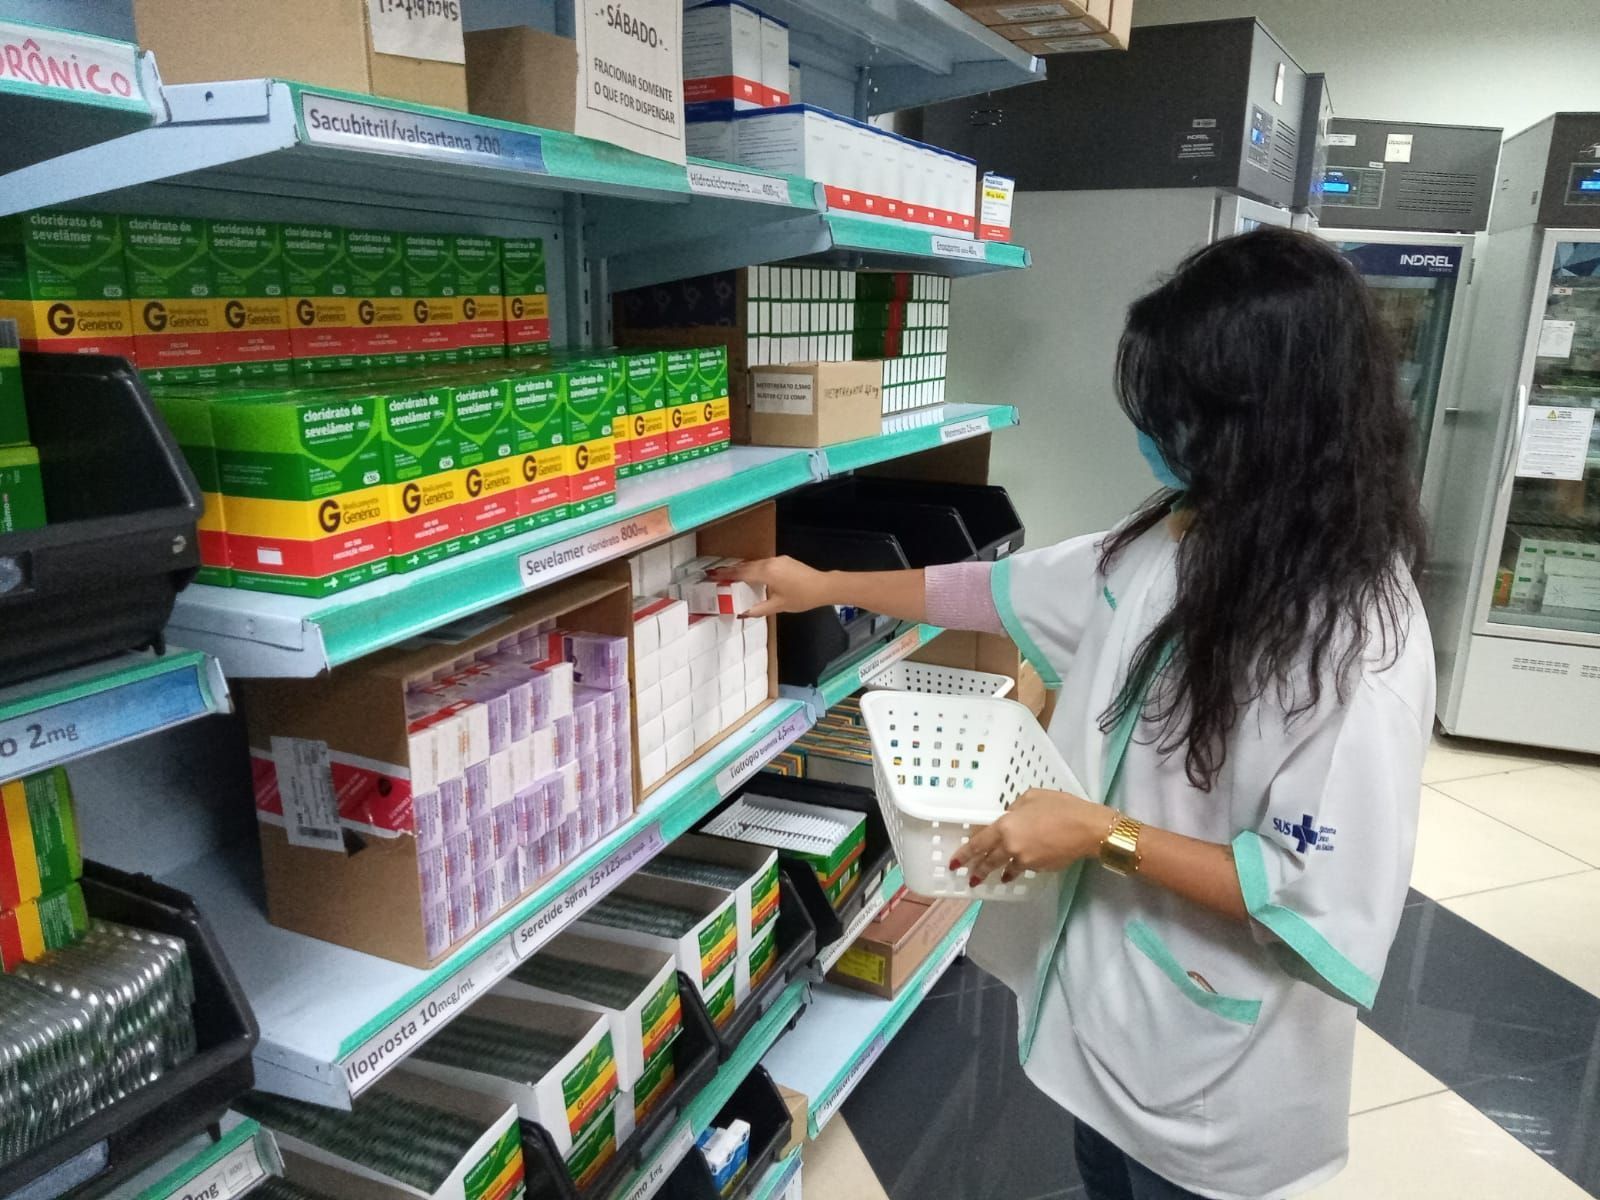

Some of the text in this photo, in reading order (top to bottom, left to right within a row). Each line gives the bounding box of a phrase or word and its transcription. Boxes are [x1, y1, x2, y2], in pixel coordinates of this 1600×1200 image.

[607, 3, 657, 48] SÁBADO
[594, 57, 637, 89] FRACIONAR
[638, 77, 673, 103] SOMENTE
[594, 81, 675, 125] O QUE FOR DISPENSAR
[310, 108, 472, 152] Sacubitril/valsartana
[30, 213, 88, 228] cloridrato
[1400, 254, 1454, 268] INDREL
[47, 302, 75, 336] G
[143, 301, 167, 332] G
[224, 300, 246, 328] G
[297, 299, 316, 325] G
[358, 299, 375, 325] G
[414, 300, 429, 323] G
[463, 298, 476, 320] G
[511, 297, 524, 319] G
[455, 386, 499, 403] cloridrato de
[515, 381, 545, 393] cloridrato
[304, 404, 364, 423] cloridrato de
[389, 394, 439, 412] cloridrato de
[704, 403, 713, 422] G
[305, 421, 355, 438] sevelâmer
[390, 411, 432, 427] sevelâmer
[634, 415, 645, 436] G
[672, 408, 682, 428] G
[522, 455, 538, 482] G
[576, 445, 589, 471] G
[466, 468, 482, 498] G
[402, 483, 421, 514] G
[318, 499, 341, 533] G
[526, 523, 649, 576] Sevelamer cloridrato 800mg
[26, 723, 78, 752] 2mg
[730, 750, 760, 779] Tiotrópio
[1273, 817, 1291, 836] SUS
[520, 905, 563, 943] Seretide
[565, 884, 589, 909] Spray
[346, 1020, 418, 1083] Iloprosta
